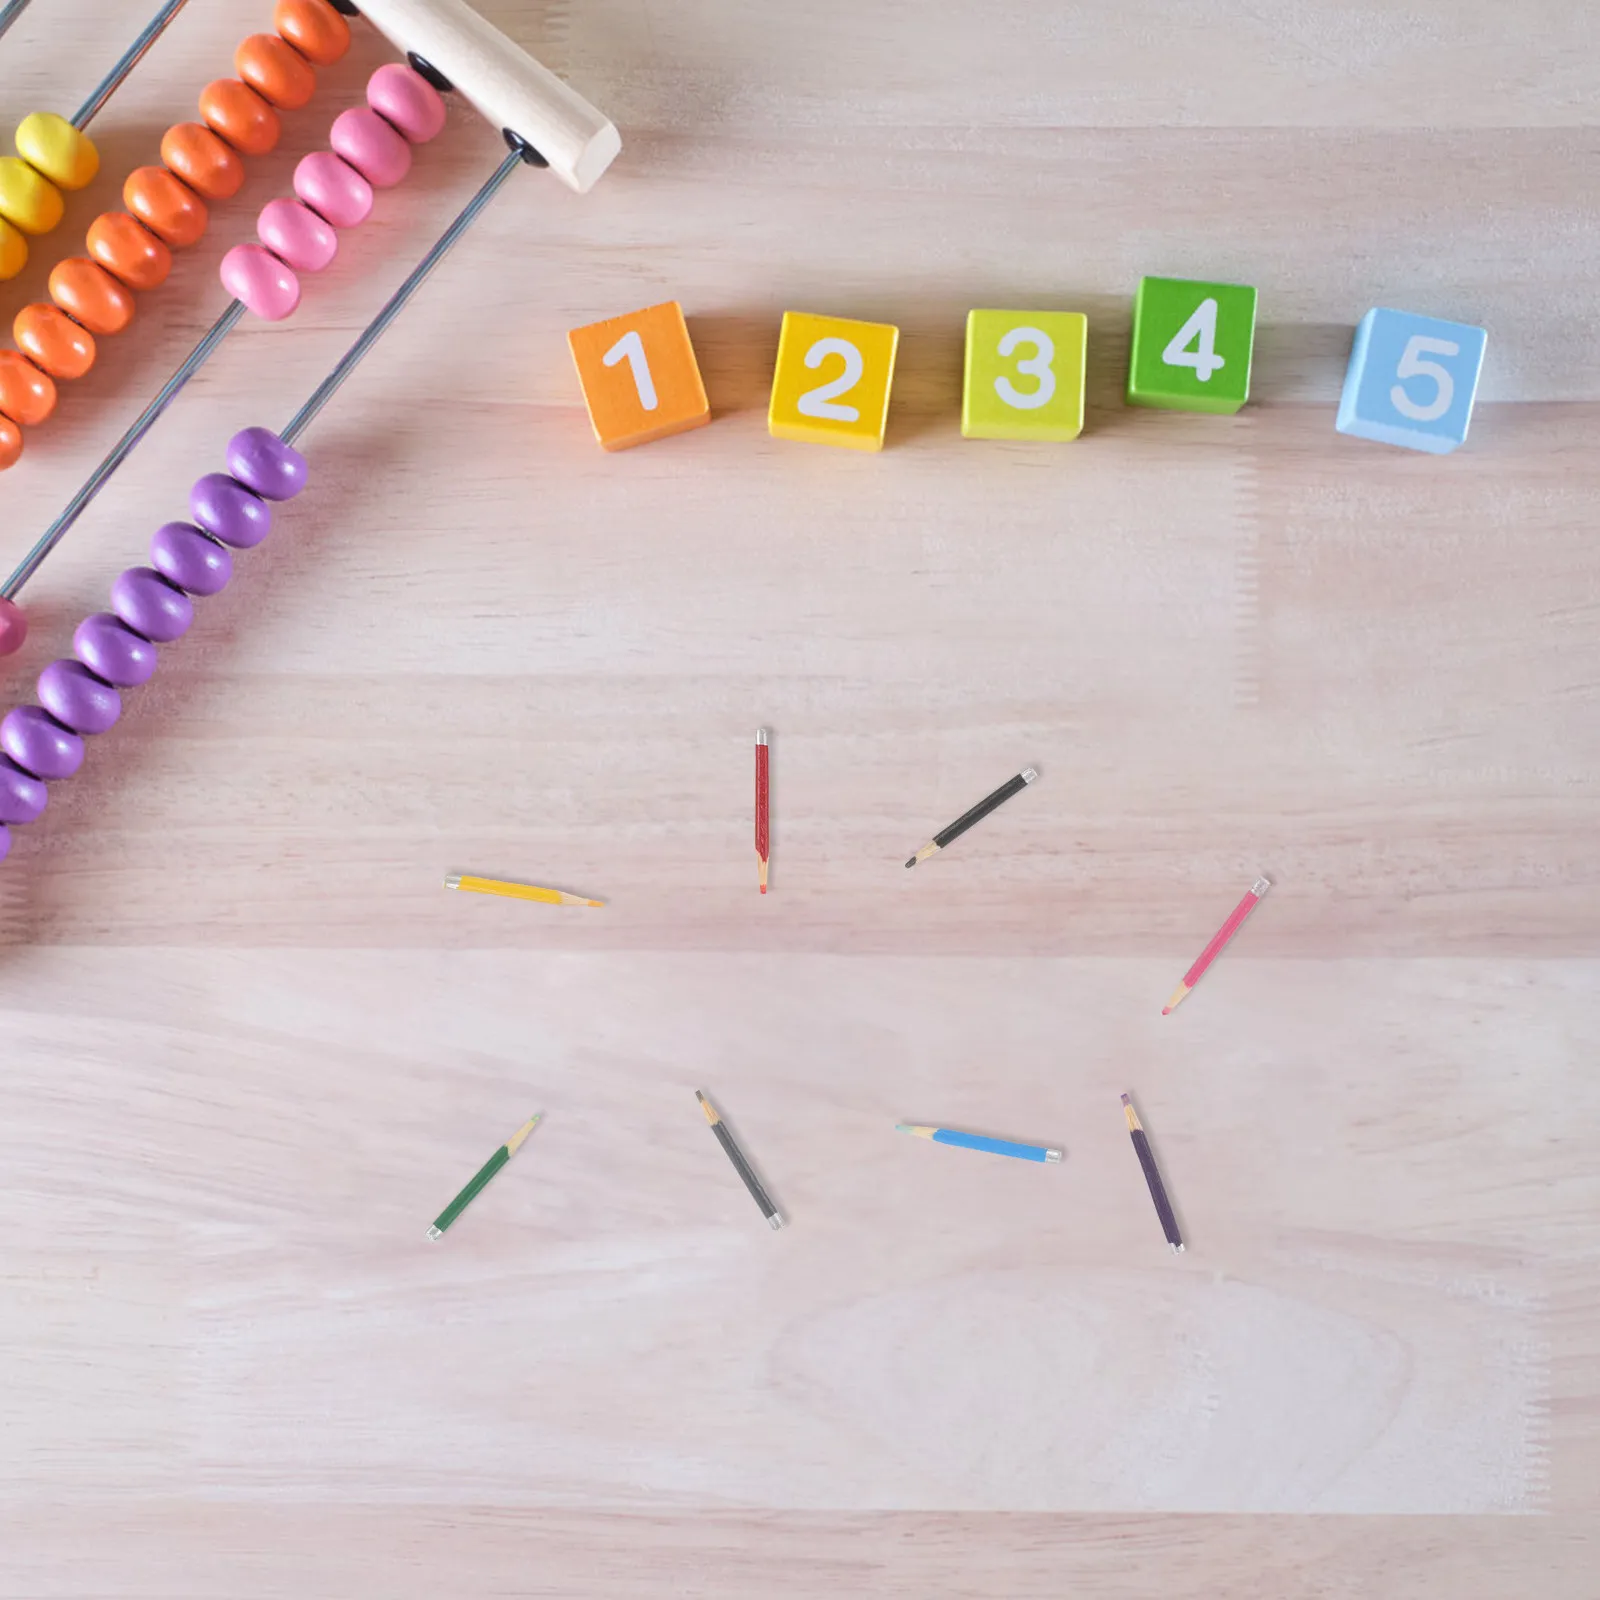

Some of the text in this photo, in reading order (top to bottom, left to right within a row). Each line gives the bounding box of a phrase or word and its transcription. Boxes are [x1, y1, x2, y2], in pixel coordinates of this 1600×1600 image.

[602, 330, 659, 411] 1
[797, 337, 864, 422] 2
[994, 326, 1056, 409] 3
[1162, 298, 1225, 382] 4
[1390, 335, 1459, 420] 5
